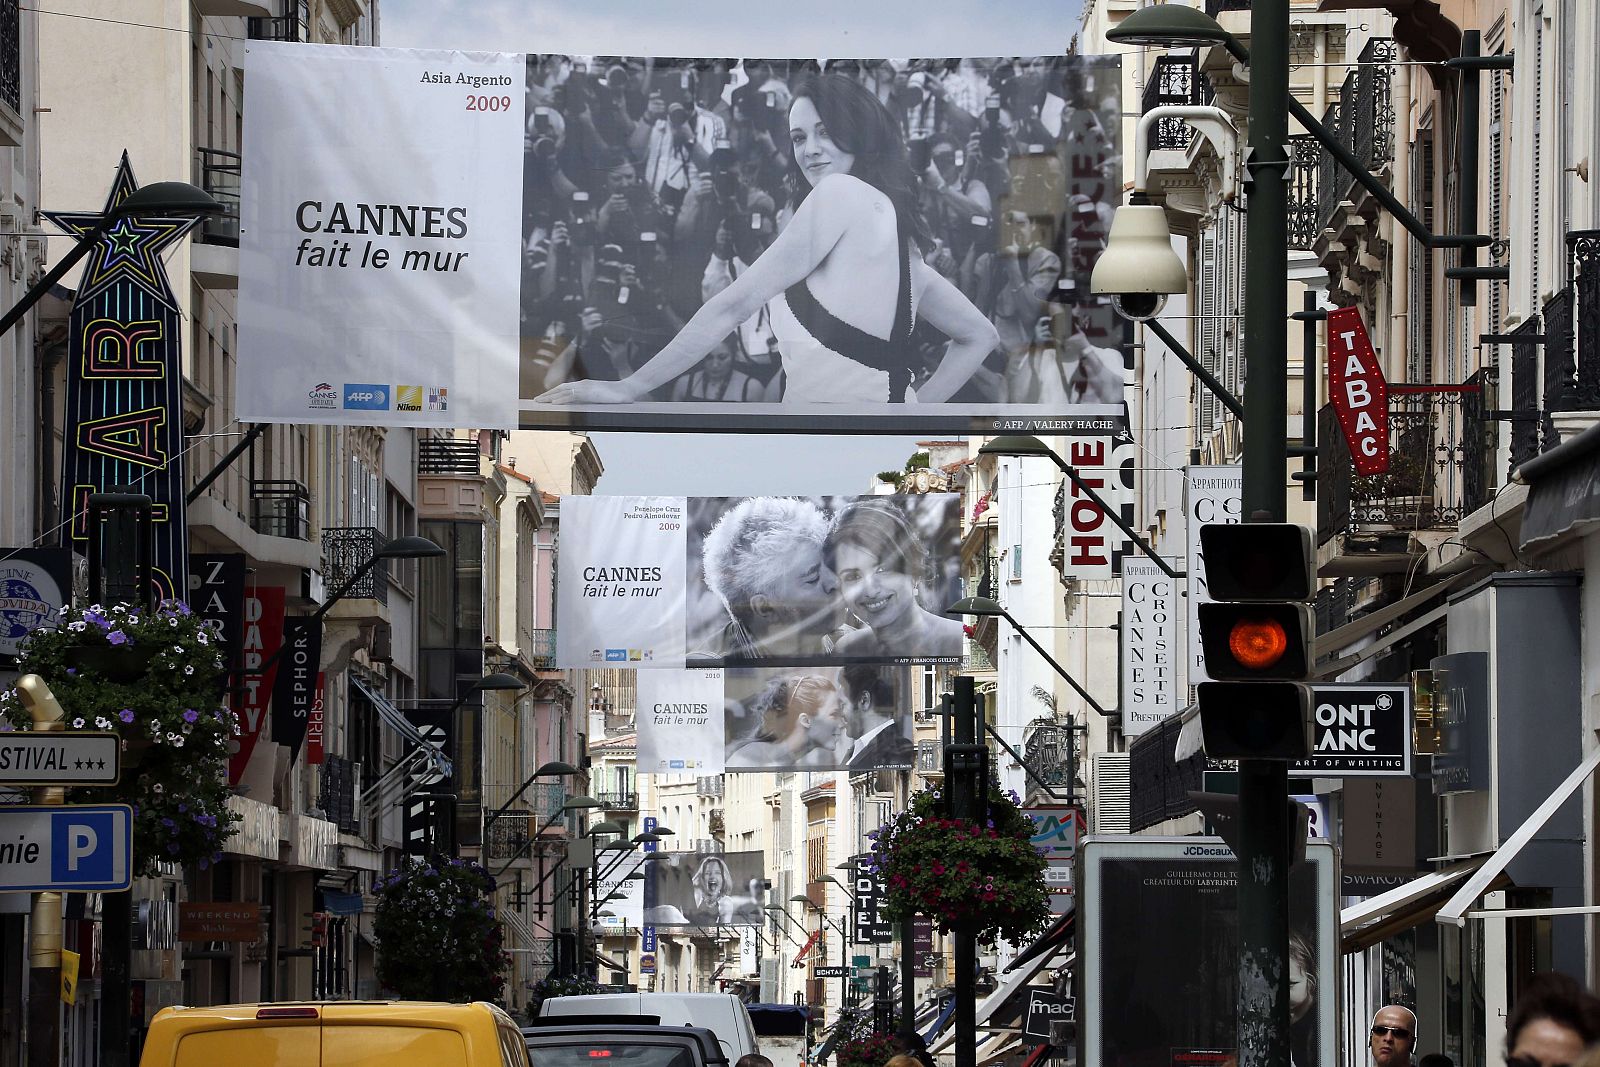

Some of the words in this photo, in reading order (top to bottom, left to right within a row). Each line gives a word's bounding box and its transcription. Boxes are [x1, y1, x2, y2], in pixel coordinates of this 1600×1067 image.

[420, 71, 451, 84] Asia
[455, 72, 512, 88] Argento
[465, 94, 511, 112] 2009
[295, 200, 468, 239] CANNES
[295, 238, 351, 267] fait
[360, 241, 390, 268] le
[401, 249, 468, 272] mur
[348, 392, 373, 402] AFP
[1340, 330, 1378, 457] TABAC
[1004, 420, 1024, 428] AFP
[1033, 420, 1074, 429] VALERY
[1077, 420, 1113, 429] HACHE
[1071, 440, 1109, 566] HOTE
[659, 523, 680, 531] 2009
[583, 567, 662, 582] CANNES
[203, 561, 228, 642] ZAR
[583, 584, 608, 598] fait
[612, 584, 626, 597] le
[631, 586, 662, 597] mur
[1128, 582, 1146, 704] CANNES
[1152, 582, 1169, 705] CROISETTE
[245, 598, 264, 732] DARTY
[653, 704, 708, 714] CANNES
[1316, 704, 1376, 726] ONT
[654, 714, 671, 726] fait
[674, 715, 684, 724] le
[686, 716, 708, 725] mur
[1314, 729, 1376, 750] ANC
[68, 824, 98, 871] P
[1184, 846, 1233, 856] JCDecaux
[857, 862, 872, 942] HOTEL
[1031, 1000, 1074, 1014] fnac
